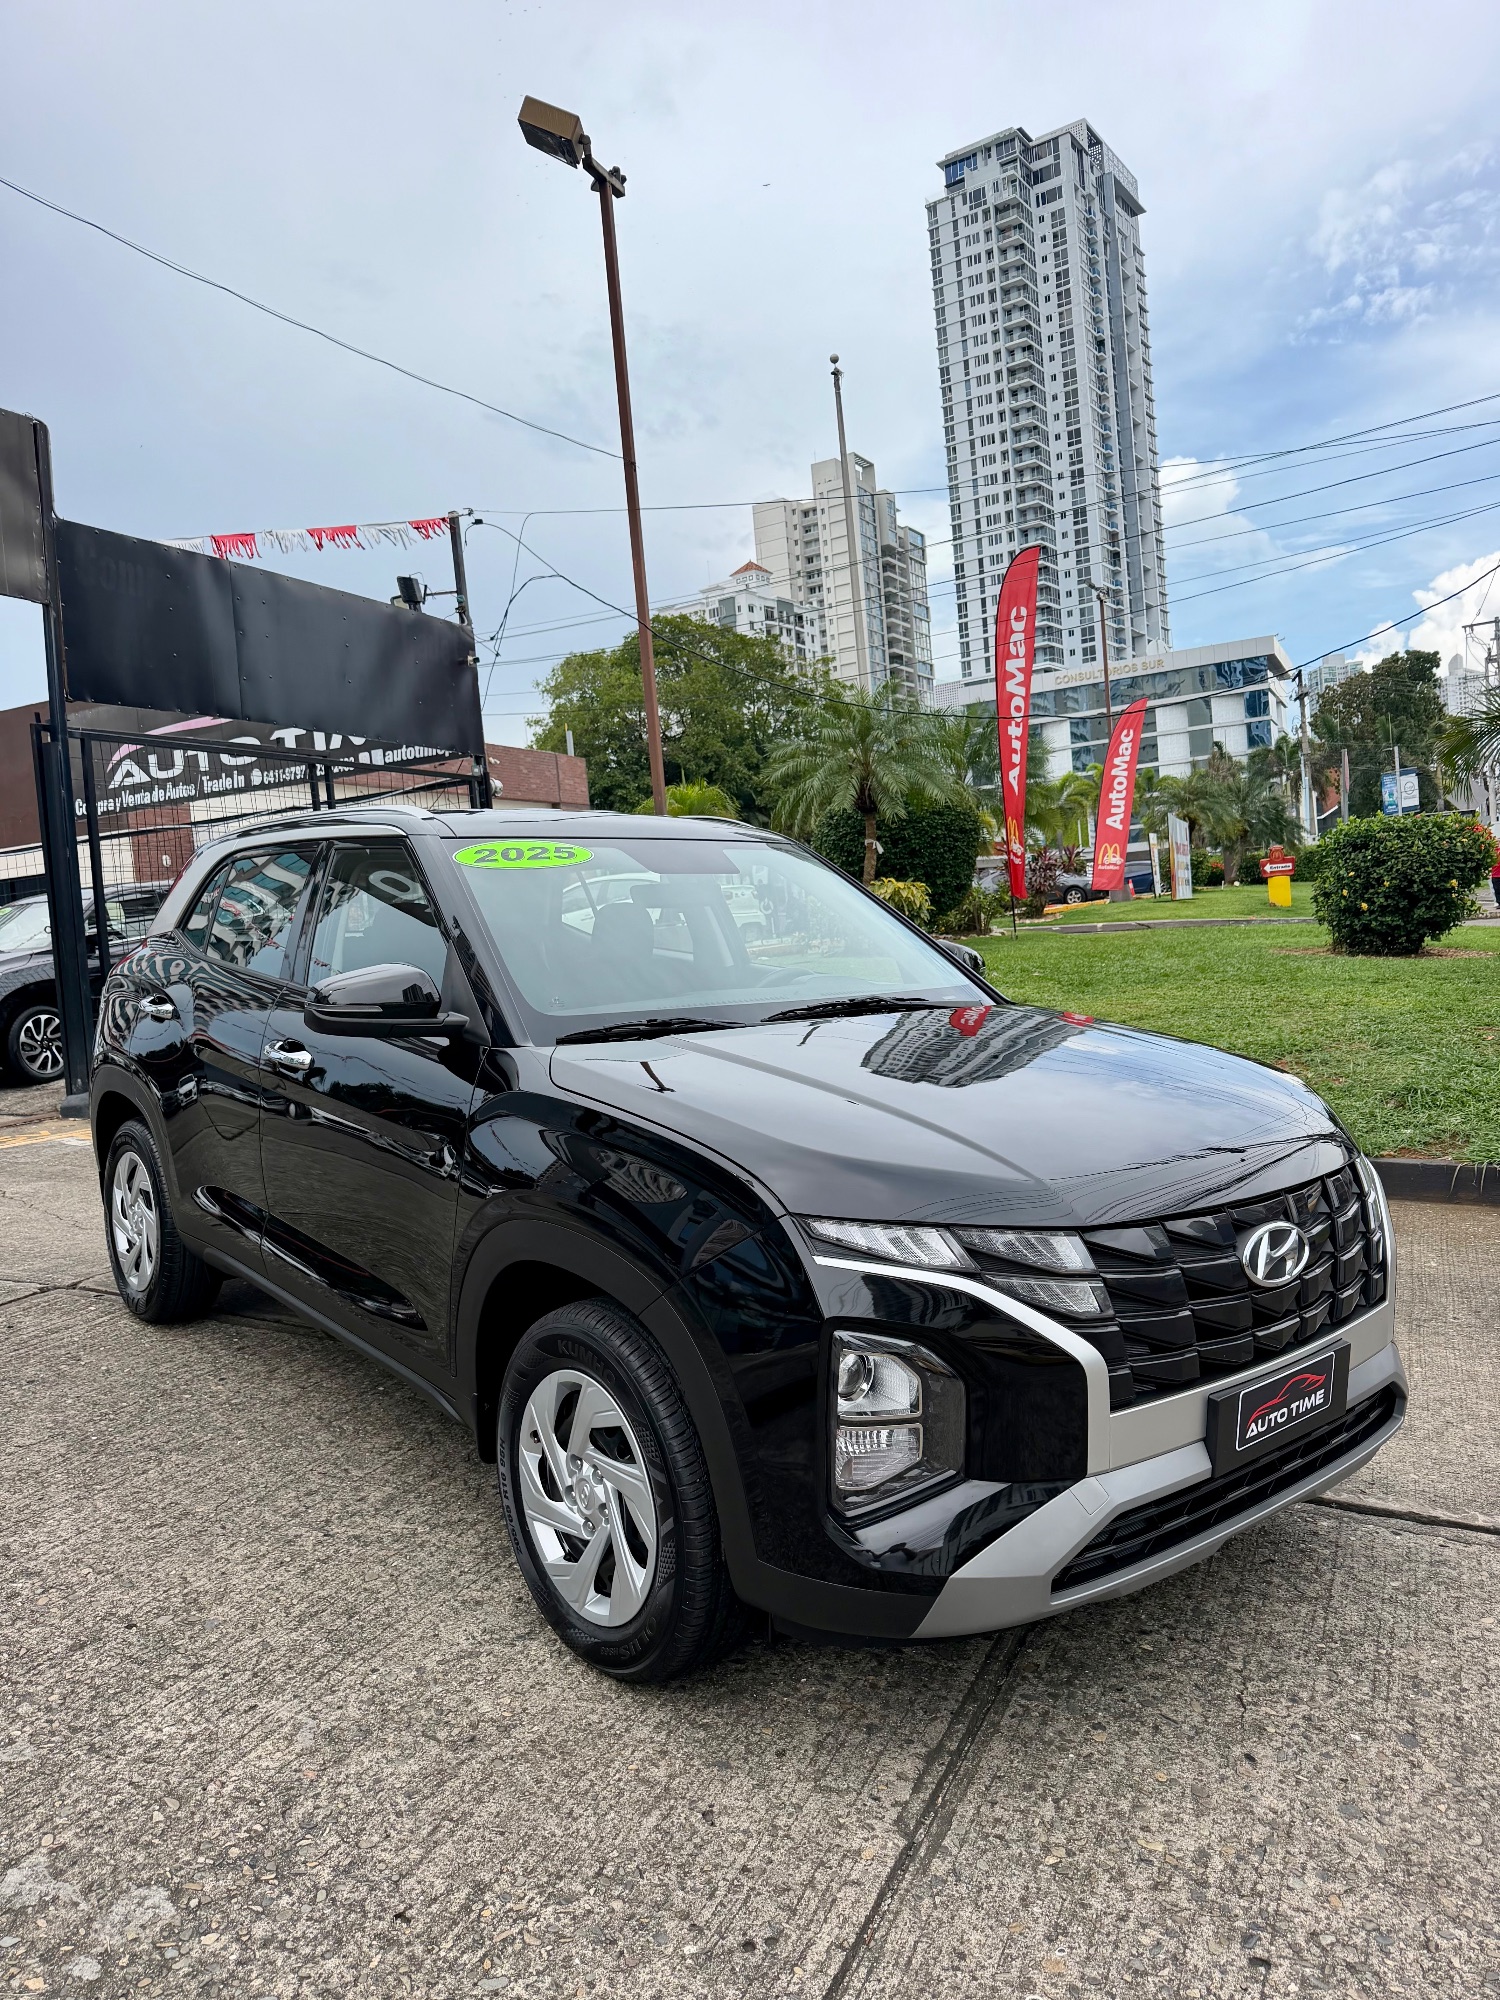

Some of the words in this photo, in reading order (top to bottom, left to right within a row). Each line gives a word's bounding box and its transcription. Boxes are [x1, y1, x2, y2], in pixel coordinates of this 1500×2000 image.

[1055, 663, 1138, 685] CONSULTORIOS
[1141, 659, 1165, 671] SUR
[1005, 605, 1027, 796] AutoMac
[75, 798, 114, 816] Copra
[116, 797, 121, 812] y
[122, 789, 150, 807] Venta
[152, 785, 164, 802] de
[166, 782, 195, 800] Autos
[202, 773, 232, 793] Trade
[234, 770, 245, 789] In
[1105, 728, 1134, 830] AutoMac
[473, 846, 577, 864] 2025
[557, 1339, 616, 1385] KUMHO
[1245, 1407, 1288, 1439] AUTO
[1290, 1388, 1325, 1417] TIME
